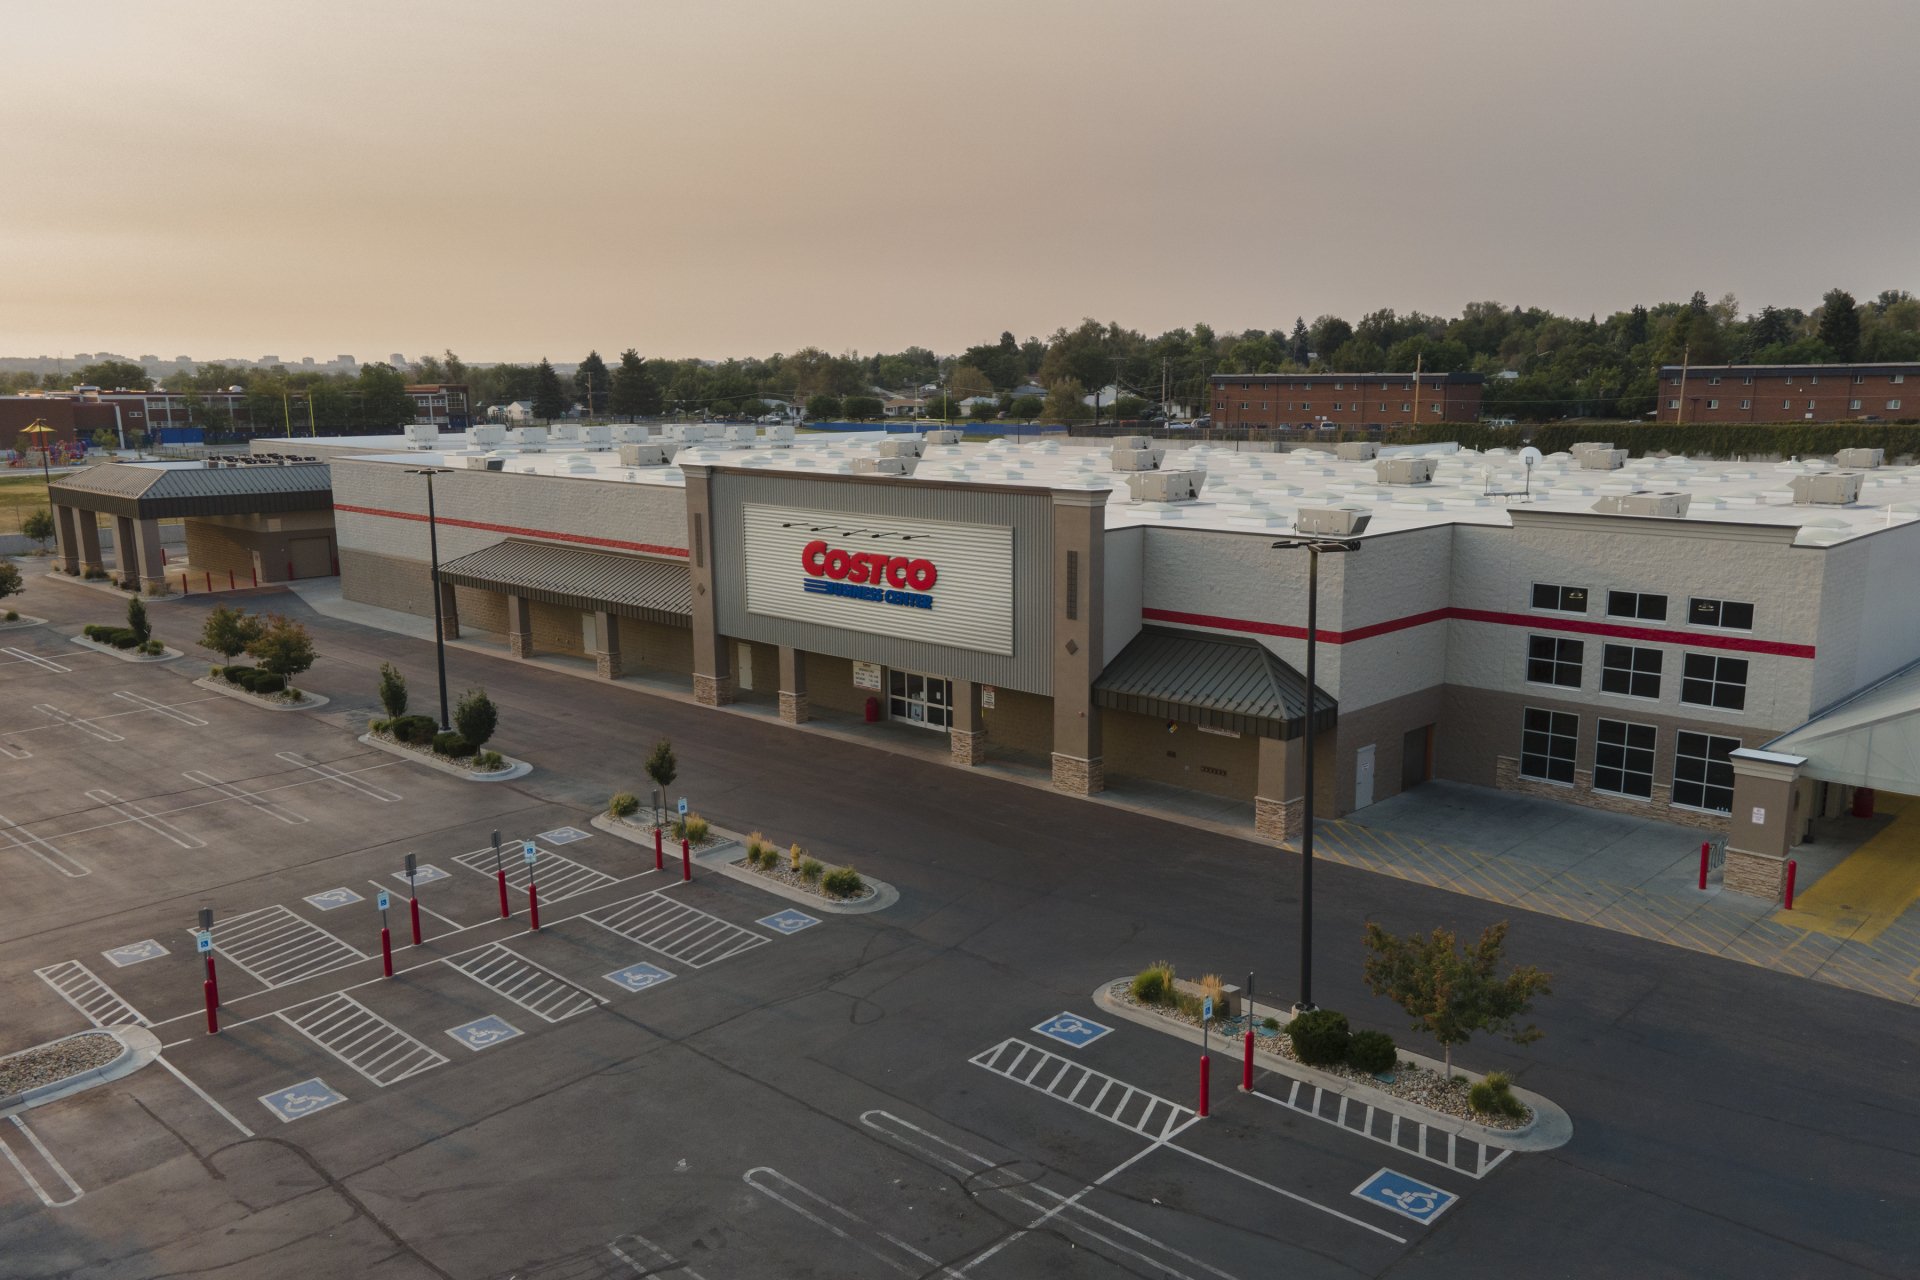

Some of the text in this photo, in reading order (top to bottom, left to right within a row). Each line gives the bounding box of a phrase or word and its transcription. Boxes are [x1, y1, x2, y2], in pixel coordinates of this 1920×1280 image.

[802, 540, 938, 591] COSTCO
[826, 581, 933, 610] BUSINESS CENTER
